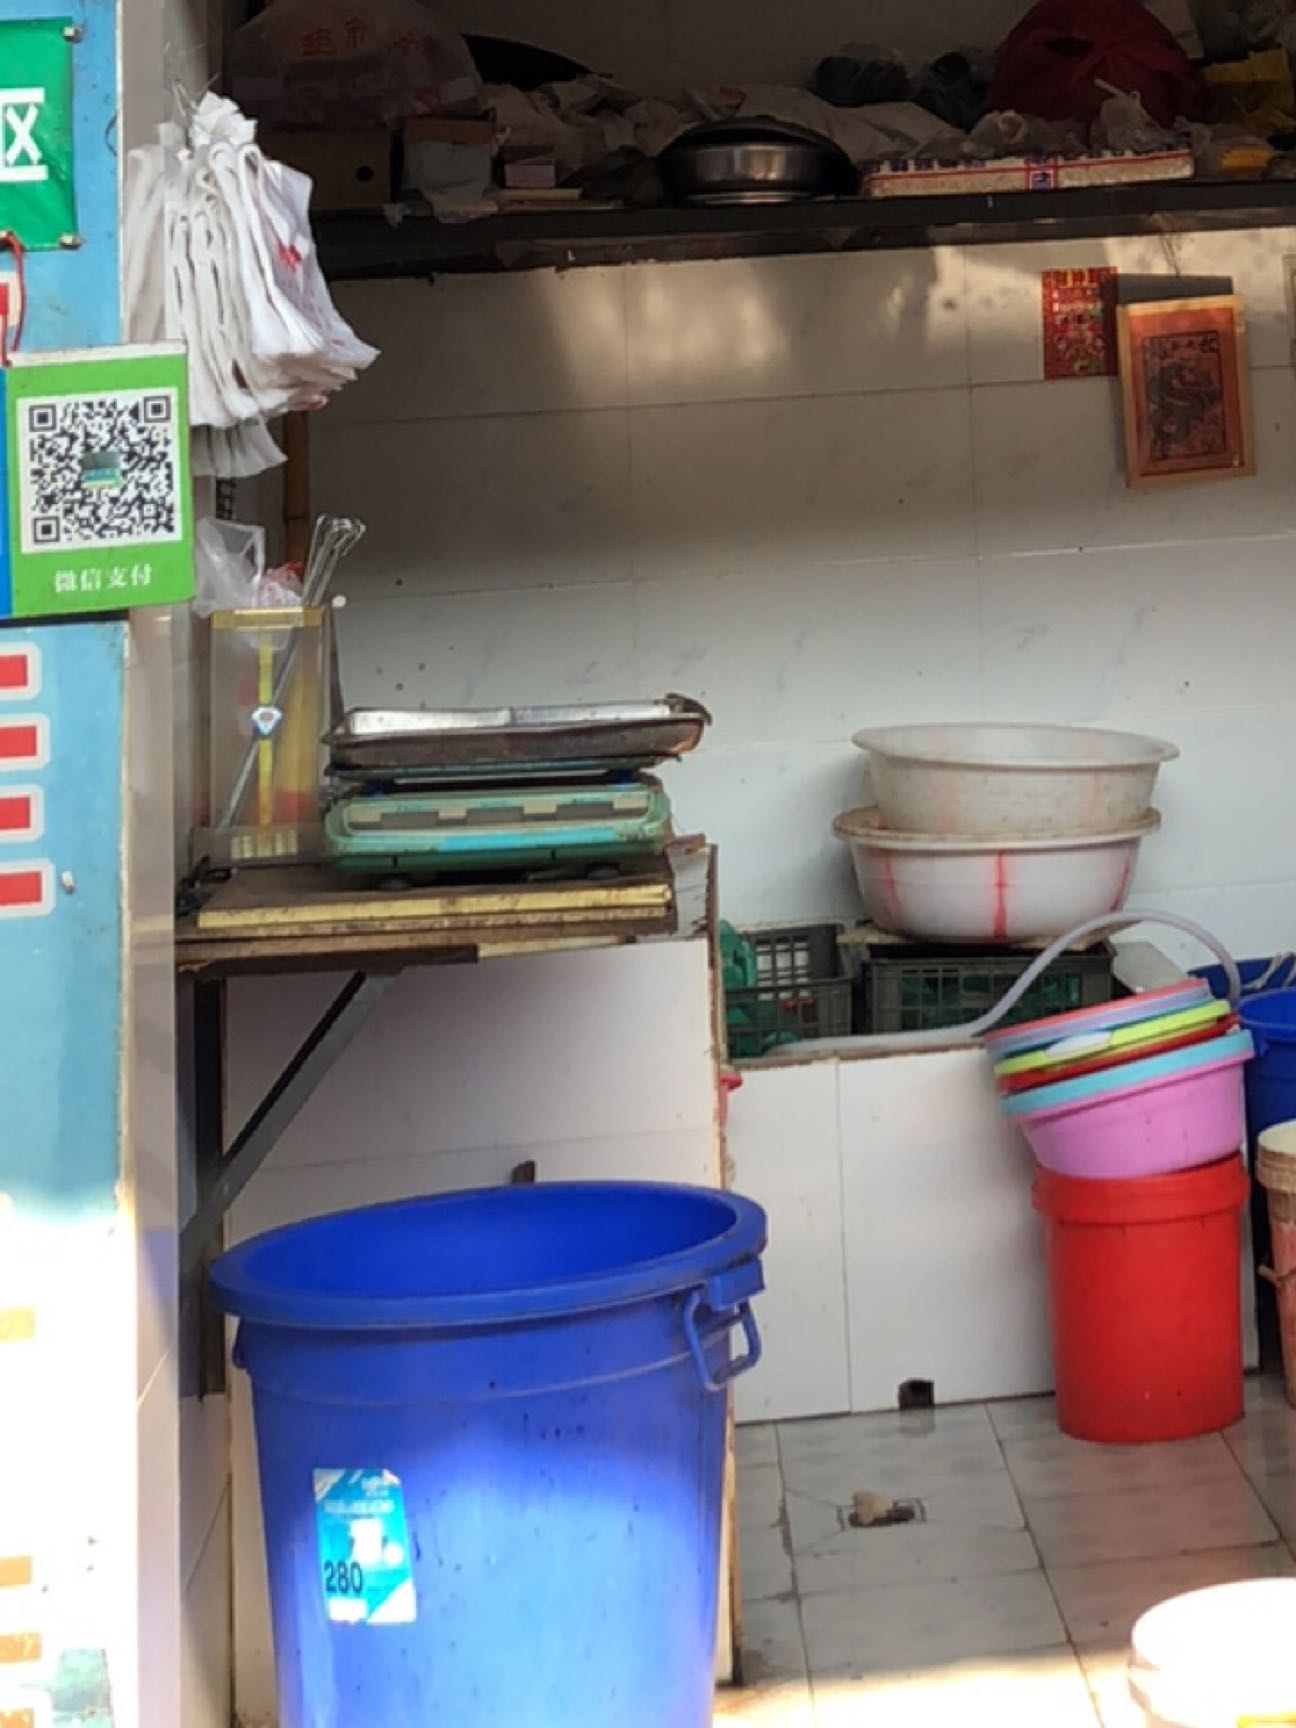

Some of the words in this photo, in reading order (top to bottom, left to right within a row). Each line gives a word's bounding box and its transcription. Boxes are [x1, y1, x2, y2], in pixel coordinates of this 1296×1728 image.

[53, 562, 153, 593] 微信支付
[323, 1560, 364, 1594] 280
